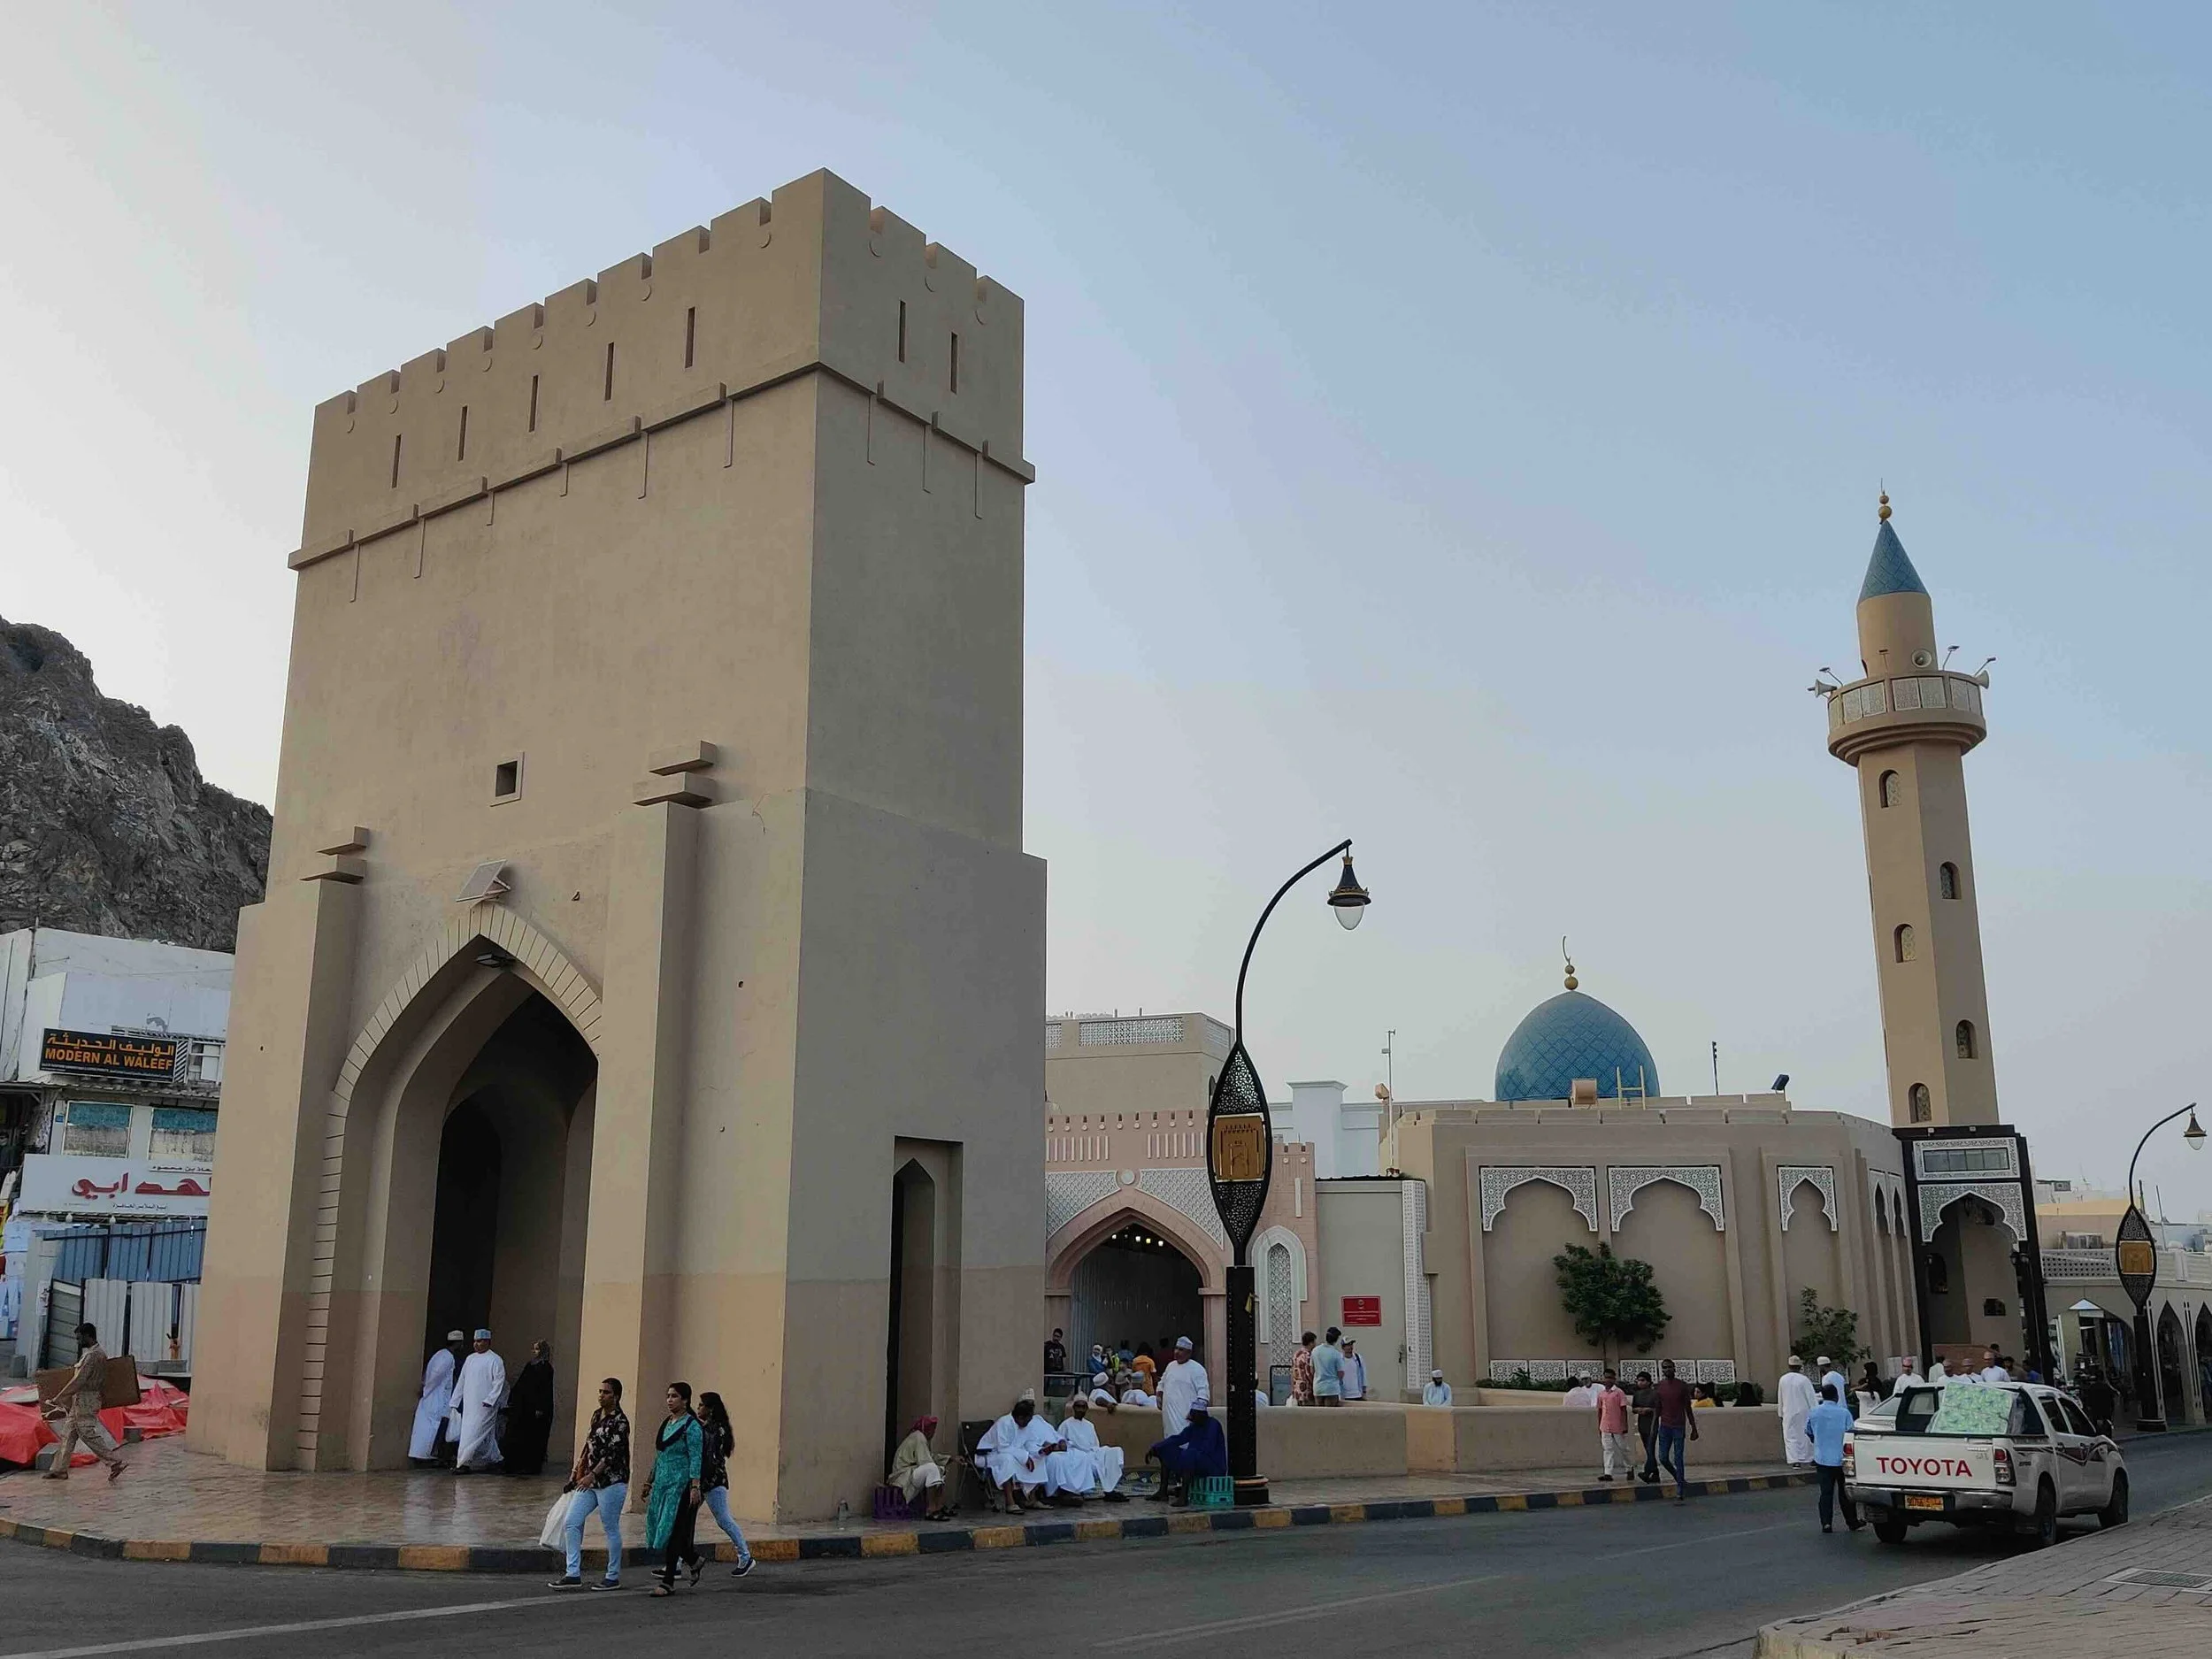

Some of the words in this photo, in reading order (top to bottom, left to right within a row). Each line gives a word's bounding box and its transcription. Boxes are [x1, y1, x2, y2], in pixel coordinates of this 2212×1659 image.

[47, 1032, 117, 1050] الحديثة
[119, 1040, 174, 1057] الوليف
[45, 1048, 100, 1064] MODERN
[104, 1054, 120, 1065] AL
[124, 1055, 173, 1071] WALEEF
[1876, 1456, 1973, 1477] TOYOTA
